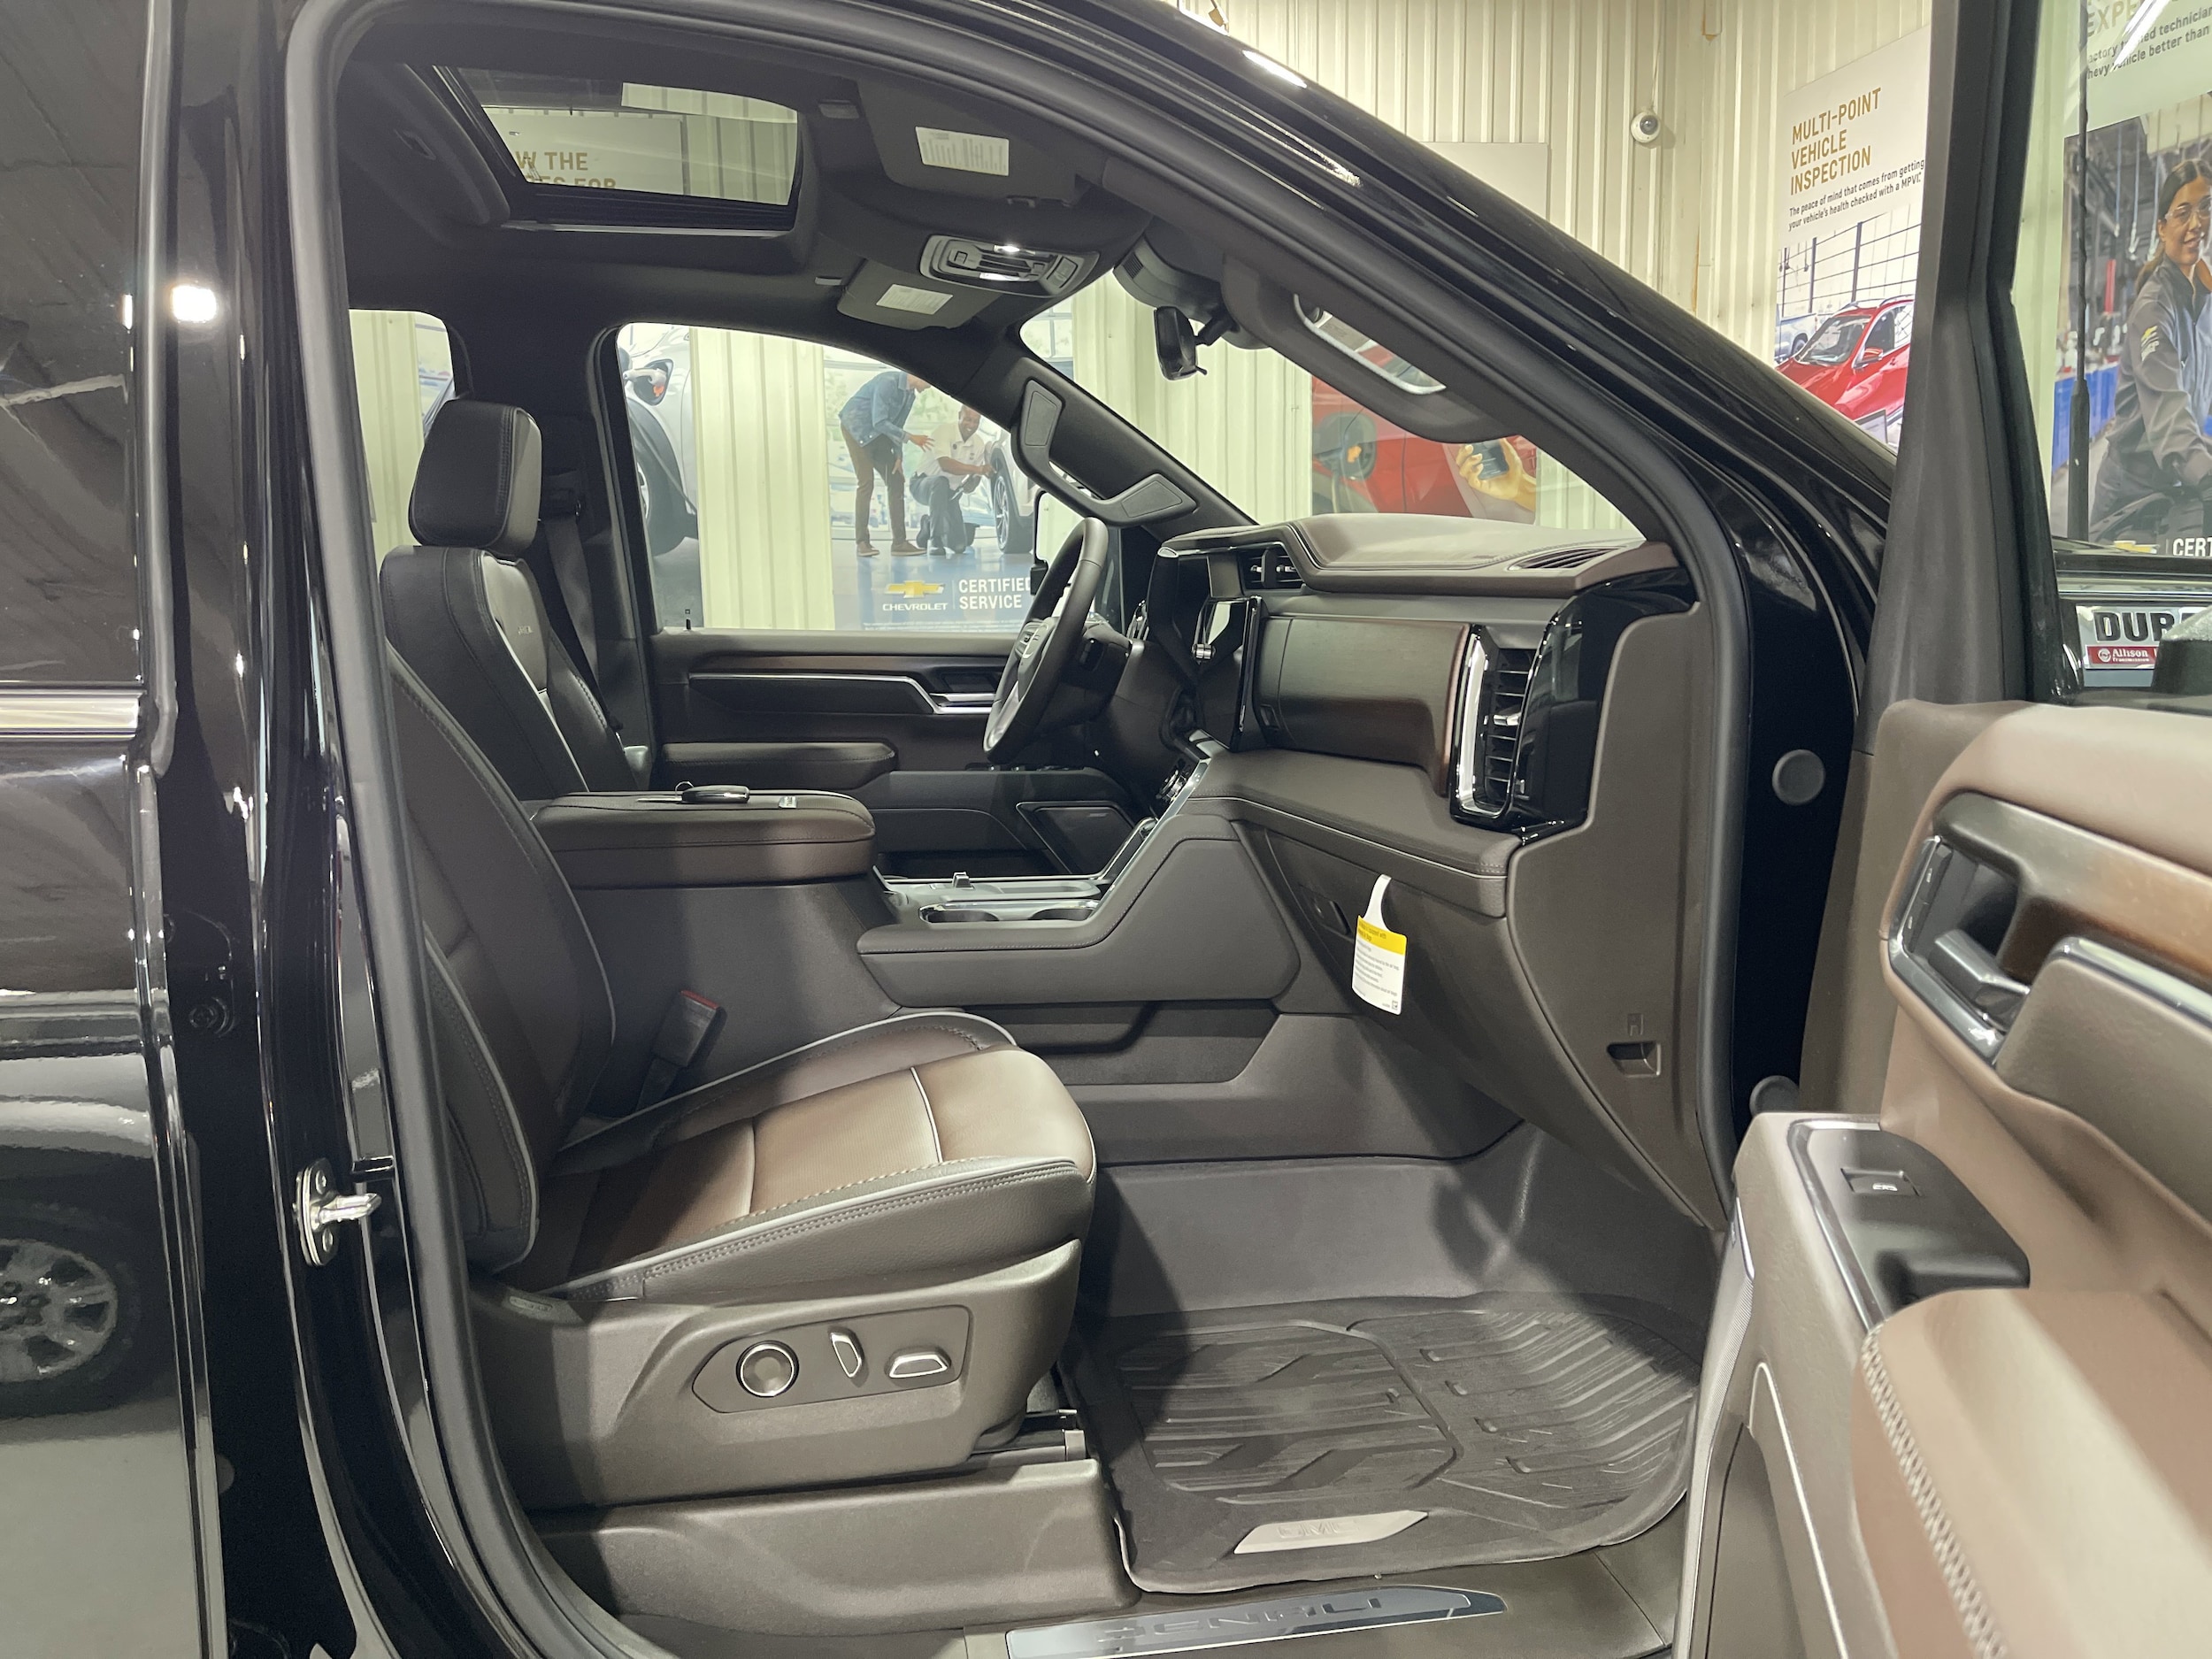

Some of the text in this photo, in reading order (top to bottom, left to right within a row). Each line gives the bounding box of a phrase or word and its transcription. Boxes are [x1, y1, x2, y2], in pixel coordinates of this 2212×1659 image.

[2087, 62, 2110, 80] hevy
[2148, 35, 2183, 57] better
[2185, 25, 2210, 42] than
[2088, 42, 2118, 64] actory
[1792, 87, 1881, 145] MULTI-POINT
[544, 151, 588, 171] THE
[1791, 128, 1847, 170] VEHICLE
[1791, 145, 1871, 196] INSPECTION
[1789, 159, 1924, 218] The peace of mind that comes from getting
[1788, 218, 1802, 232] your
[1803, 207, 1829, 224] vehicle's
[1829, 199, 1849, 215] health
[1851, 188, 1878, 208] checked
[1878, 182, 1894, 196] with
[1895, 182, 1901, 191] a
[882, 603, 949, 611] CHEVROLET
[958, 594, 1022, 610] SERVICE
[2093, 611, 2200, 642] DUR
[2112, 648, 2149, 657] Allison
[1278, 1519, 1360, 1539] GMC
